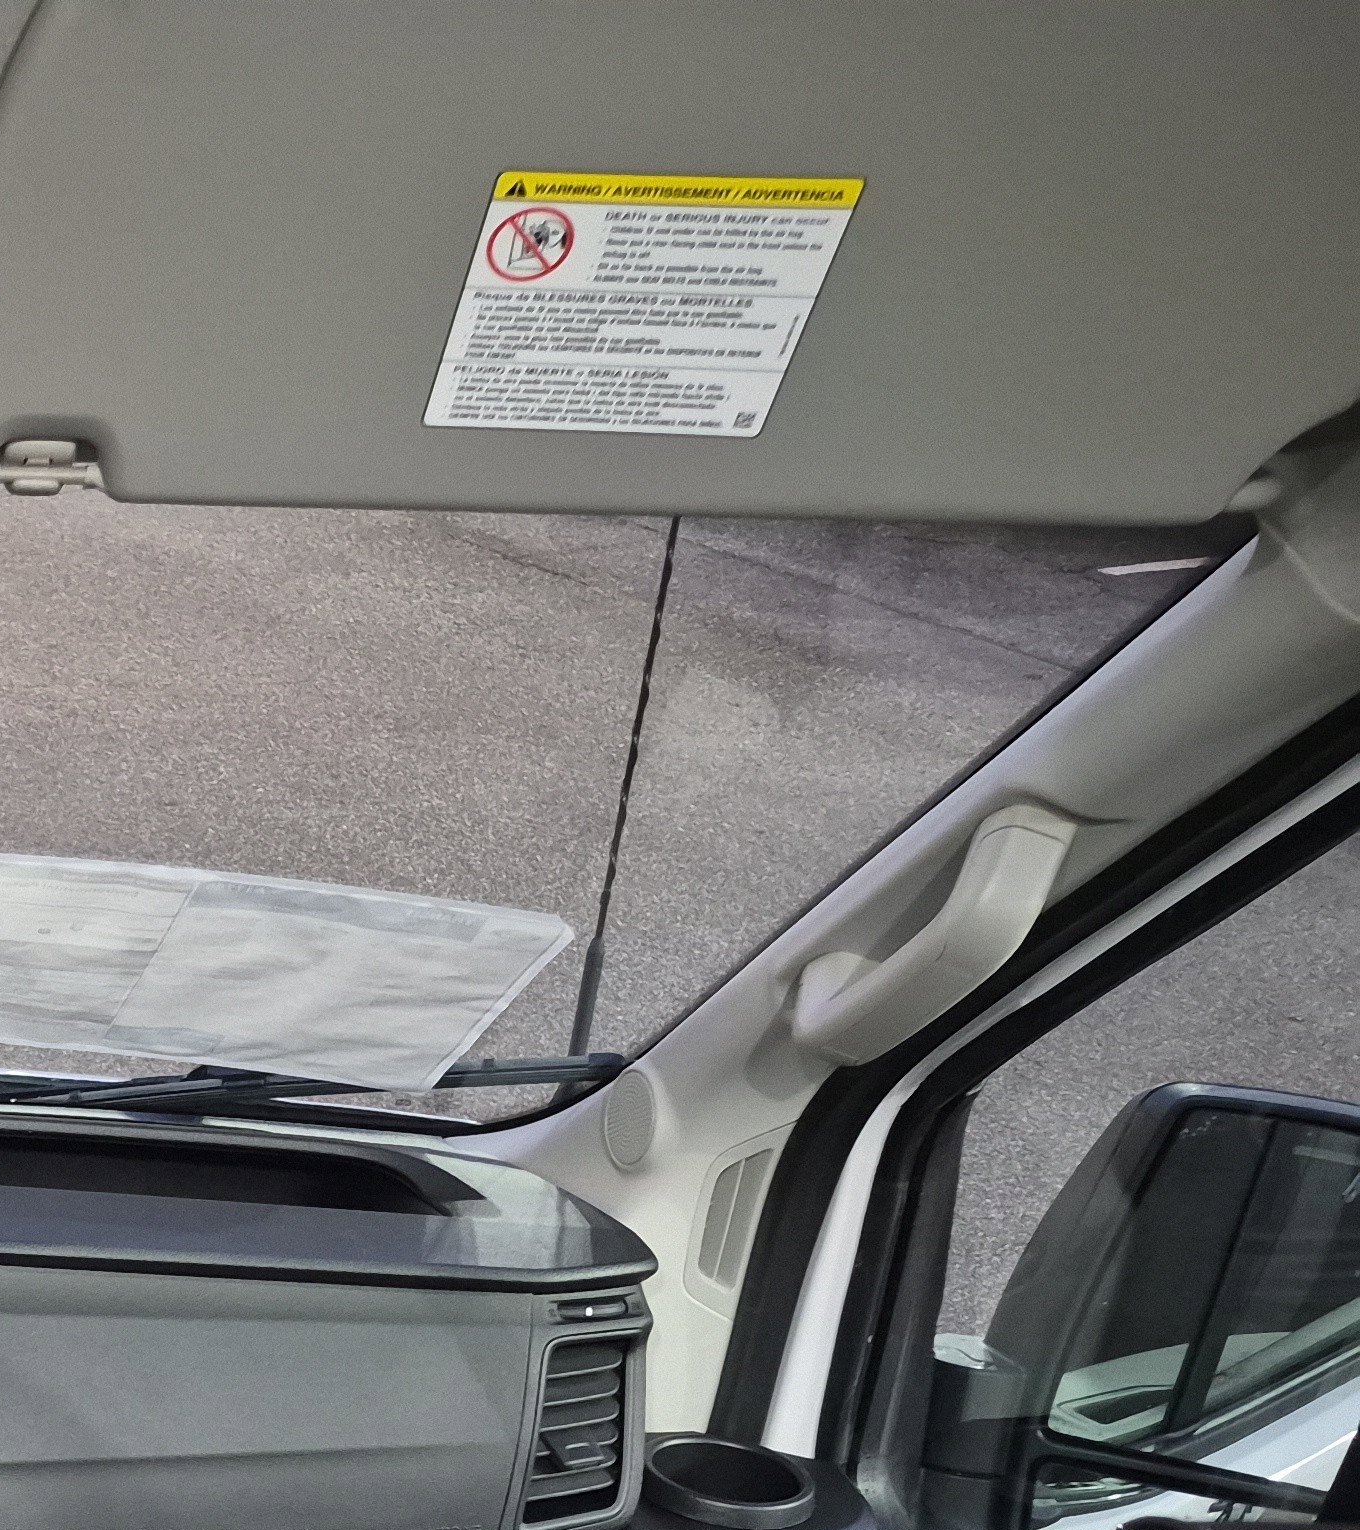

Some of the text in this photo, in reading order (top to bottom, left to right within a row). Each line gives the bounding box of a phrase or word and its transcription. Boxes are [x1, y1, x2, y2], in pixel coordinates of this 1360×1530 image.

[534, 183, 844, 202] WARNING AVERTISSEMENT ADVERTENCIA
[605, 211, 647, 221] DEATH
[723, 214, 769, 224] INJURY
